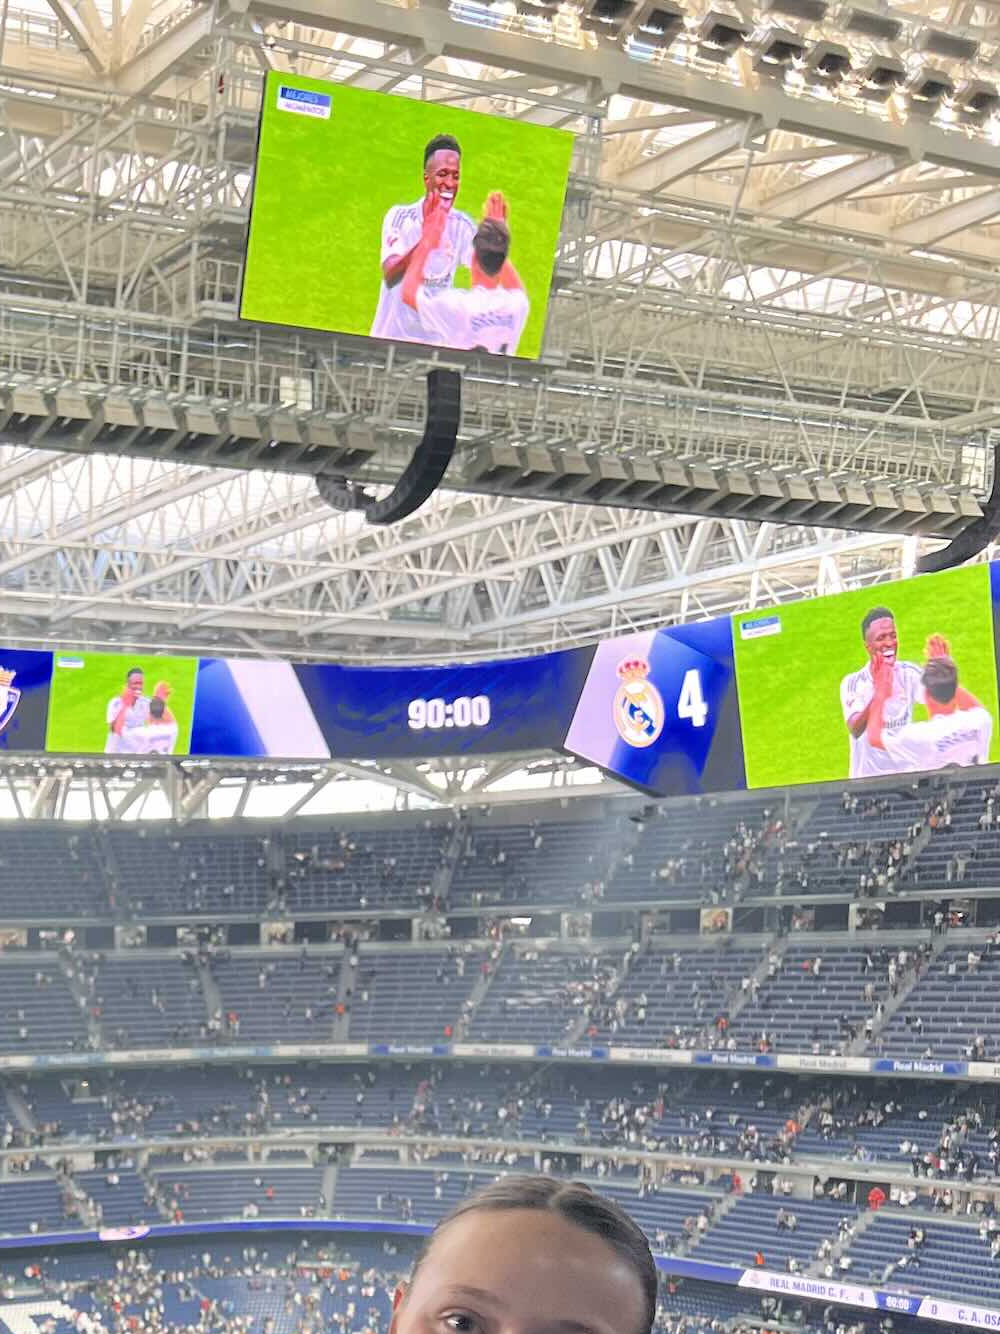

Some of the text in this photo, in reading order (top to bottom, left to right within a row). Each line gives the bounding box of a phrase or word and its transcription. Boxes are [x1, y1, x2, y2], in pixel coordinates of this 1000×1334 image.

[408, 696, 491, 729] 90:00
[678, 669, 708, 727] 4
[770, 1277, 789, 1289] REAL
[792, 1281, 826, 1295] MADRID
